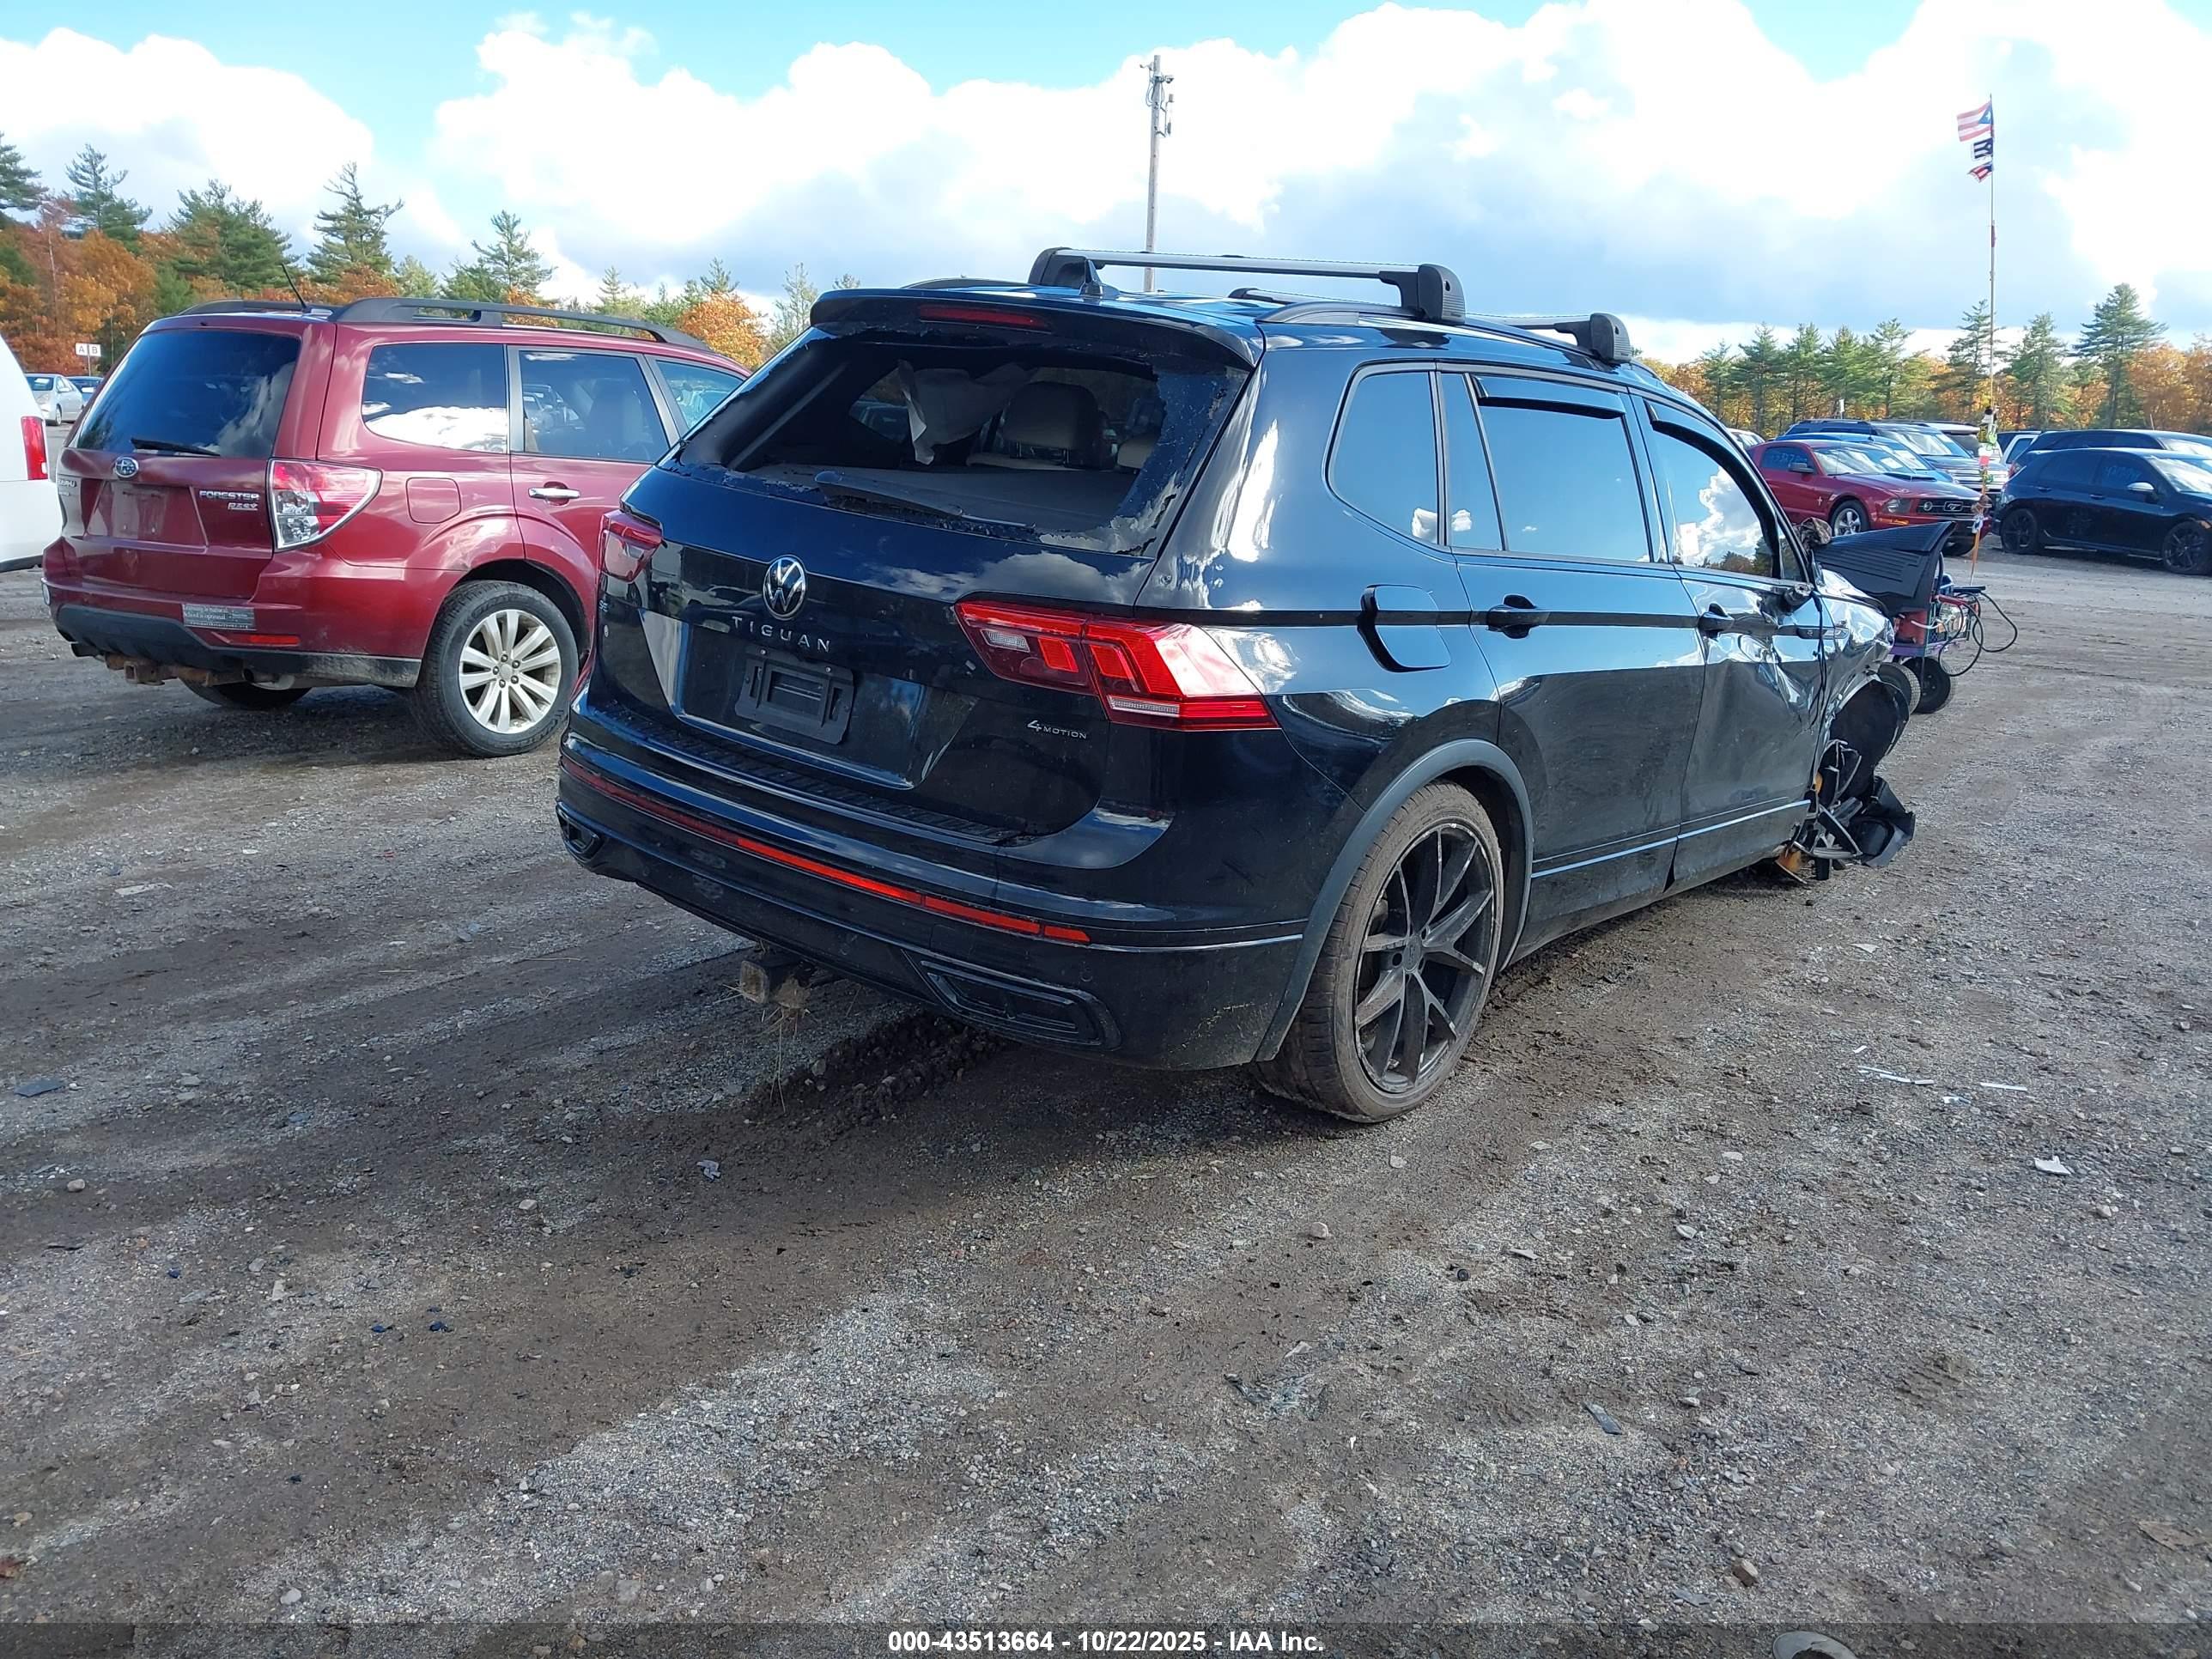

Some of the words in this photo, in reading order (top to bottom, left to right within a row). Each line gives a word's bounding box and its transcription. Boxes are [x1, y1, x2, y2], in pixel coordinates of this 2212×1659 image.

[79, 345, 85, 354] A
[199, 490, 259, 500] FORESTER
[732, 616, 830, 653] TIGUAN
[1027, 720, 1087, 739] 4MOTION
